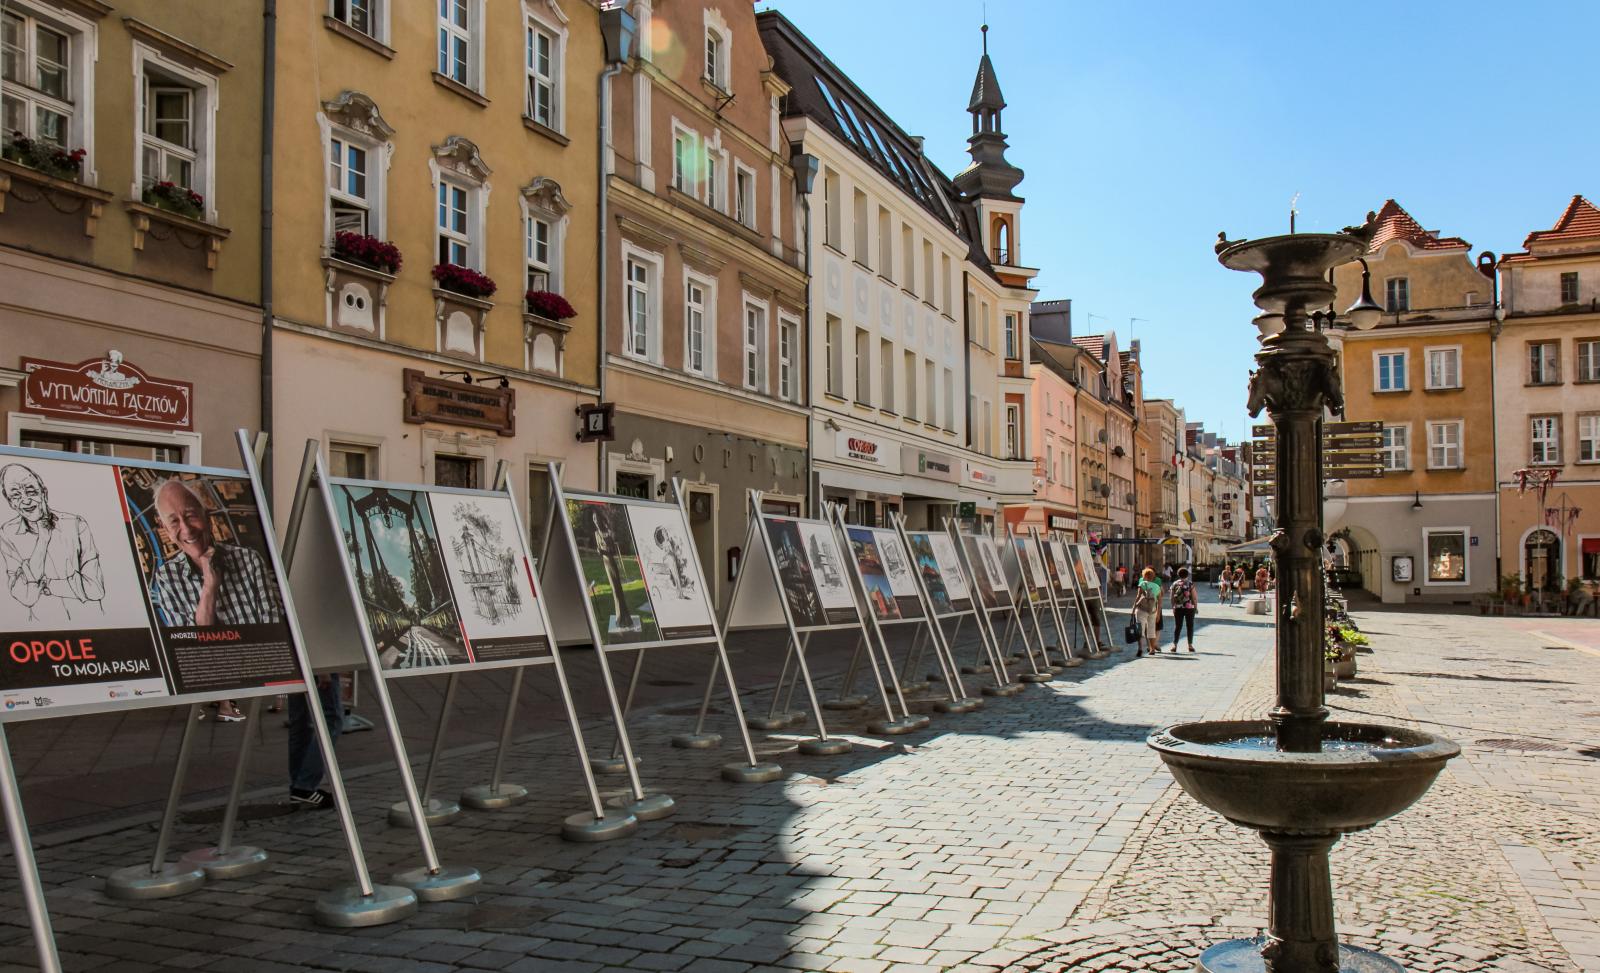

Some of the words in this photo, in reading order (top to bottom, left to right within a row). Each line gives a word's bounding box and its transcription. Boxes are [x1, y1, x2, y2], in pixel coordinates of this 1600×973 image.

[40, 381, 118, 407] WYTWÓRNIA
[123, 392, 179, 414] PĄCZKÓW
[170, 630, 197, 640] ANDRZEJ
[197, 630, 241, 641] HAMADA
[9, 639, 97, 663] OPOLE
[52, 664, 72, 677] TO
[74, 661, 112, 676] MOJA
[111, 659, 150, 674] PASJA!
